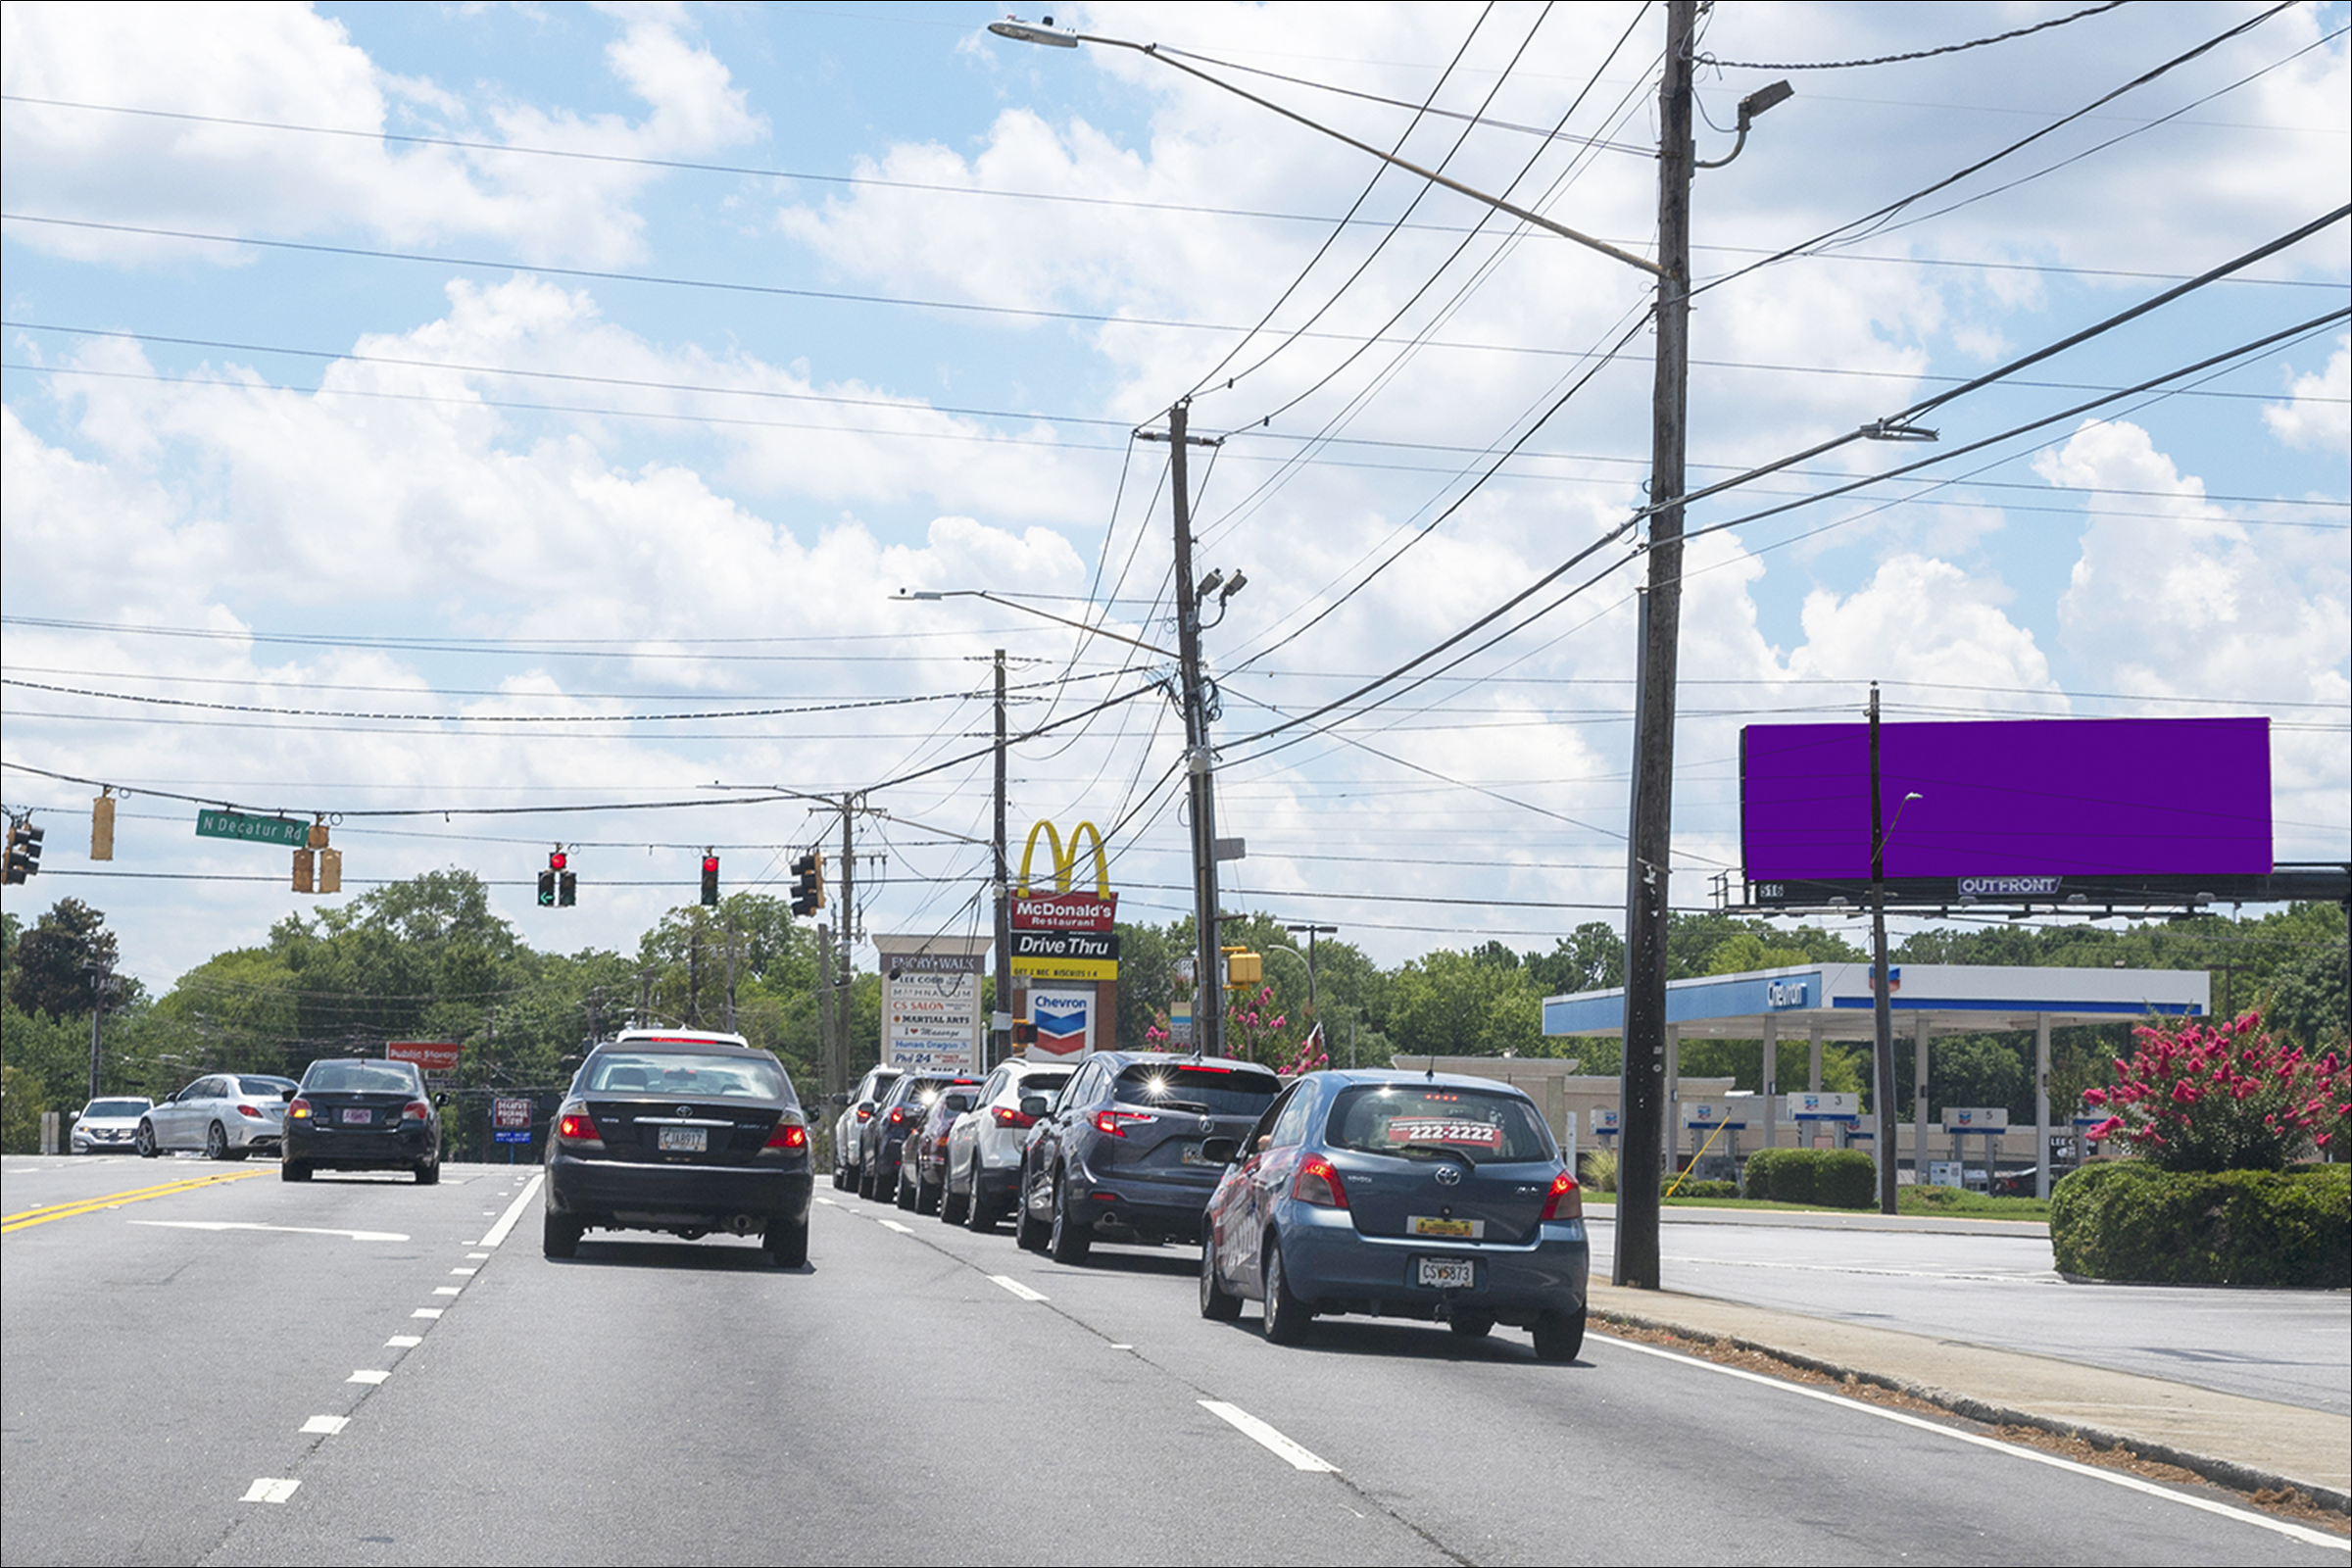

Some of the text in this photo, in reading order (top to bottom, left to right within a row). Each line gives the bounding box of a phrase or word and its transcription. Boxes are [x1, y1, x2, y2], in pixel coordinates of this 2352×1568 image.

[203, 816, 302, 841] N Decatur Rd
[1962, 878, 2056, 893] OUTFRONT
[1017, 902, 1111, 917] McDonald's
[1032, 916, 1095, 927] Restaurant
[1019, 936, 1108, 955] Drive Thru
[939, 957, 974, 969] WALK
[900, 975, 913, 984] LEE
[1768, 981, 1807, 1006] Chevron
[893, 1002, 907, 1010] CS
[910, 1002, 944, 1010] SALON
[1035, 995, 1087, 1008] Chevron
[390, 1049, 459, 1059] Public Storag
[915, 1054, 931, 1063] 24
[1835, 1096, 1842, 1105] 3
[1726, 1106, 1732, 1115] 7
[1985, 1110, 1992, 1119] 5
[1409, 1125, 1494, 1142] 222-2222
